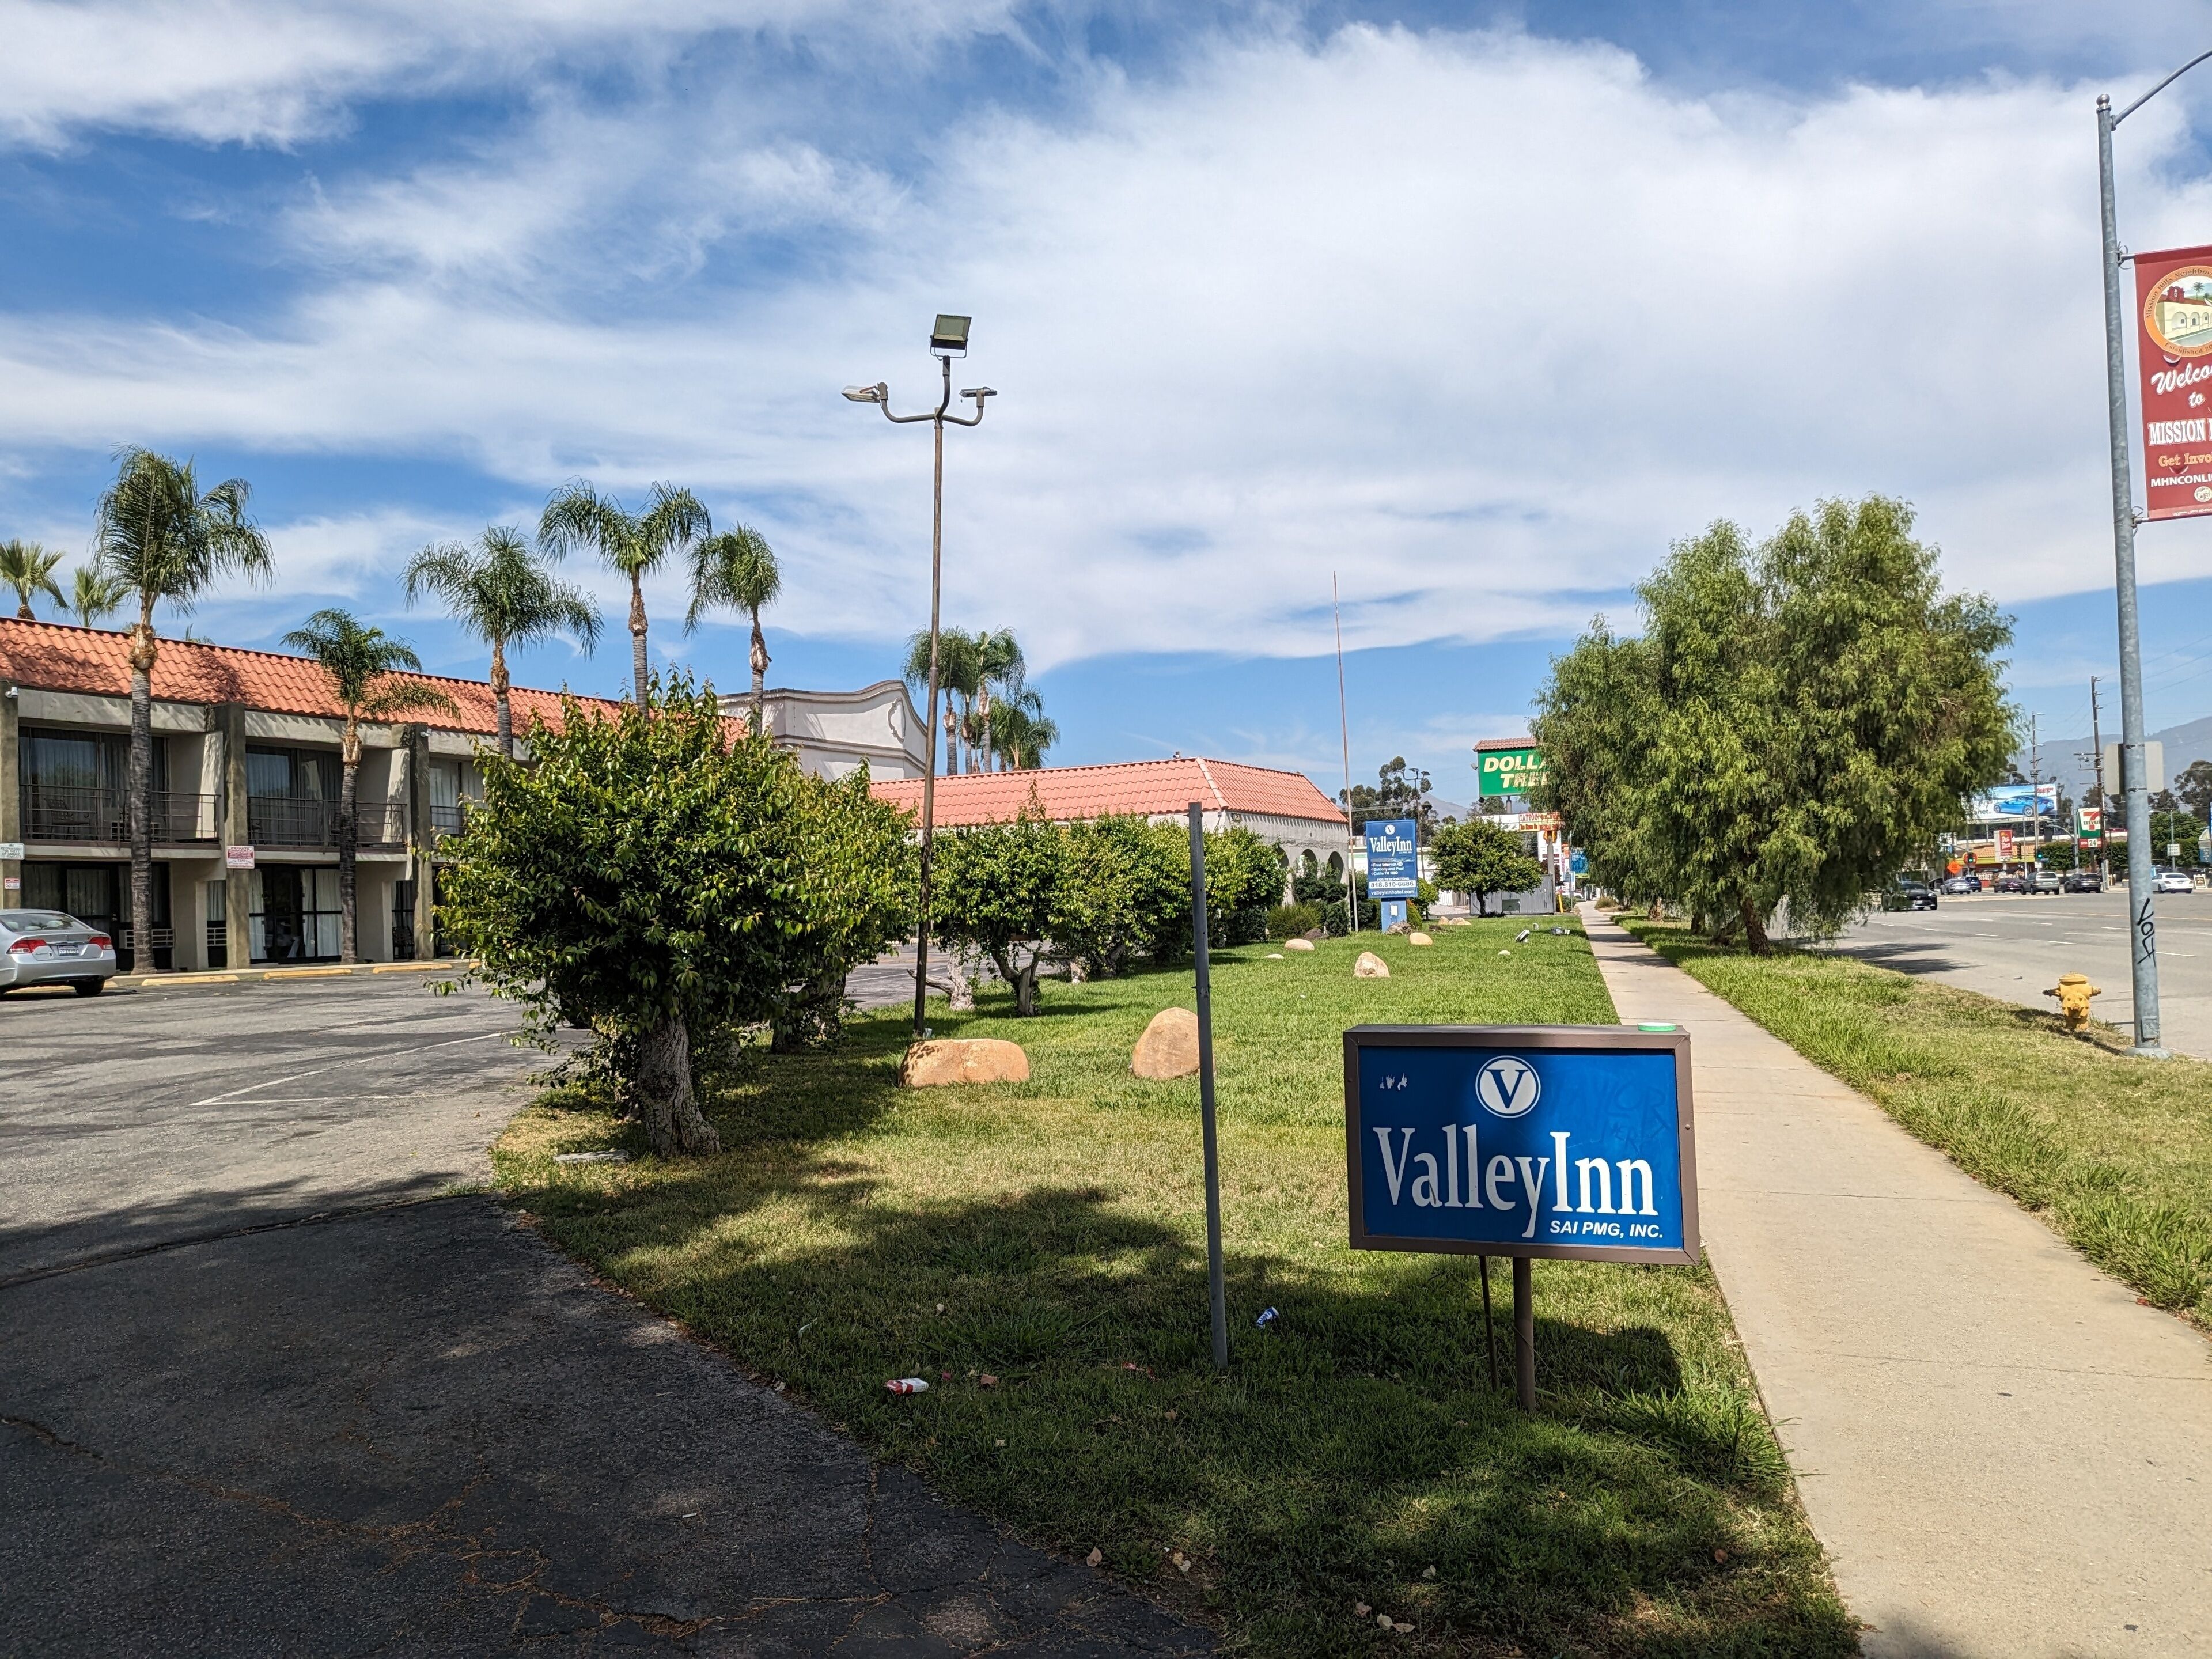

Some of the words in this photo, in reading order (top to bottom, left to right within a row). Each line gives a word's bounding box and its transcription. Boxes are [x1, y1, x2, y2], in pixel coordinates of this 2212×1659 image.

[2146, 291, 2159, 318] Mission
[2157, 277, 2173, 290] Hills
[2165, 342, 2203, 354] Established
[2150, 362, 2212, 395] Welco
[2189, 392, 2205, 408] to
[2148, 419, 2206, 446] MISSION
[2158, 454, 2181, 467] Get
[2150, 473, 2212, 487] MHNCONLI
[1484, 755, 1549, 772] DOLL
[1520, 813, 1539, 821] TATTOO
[2083, 811, 2102, 830] 7
[1369, 836, 1412, 857] ValleyInn
[1486, 1069, 1529, 1109] V
[1373, 1123, 1659, 1238] ValleyInn
[1550, 1220, 1578, 1234] SAI
[1582, 1221, 1623, 1238] PMG,
[1630, 1224, 1664, 1238] INC.
